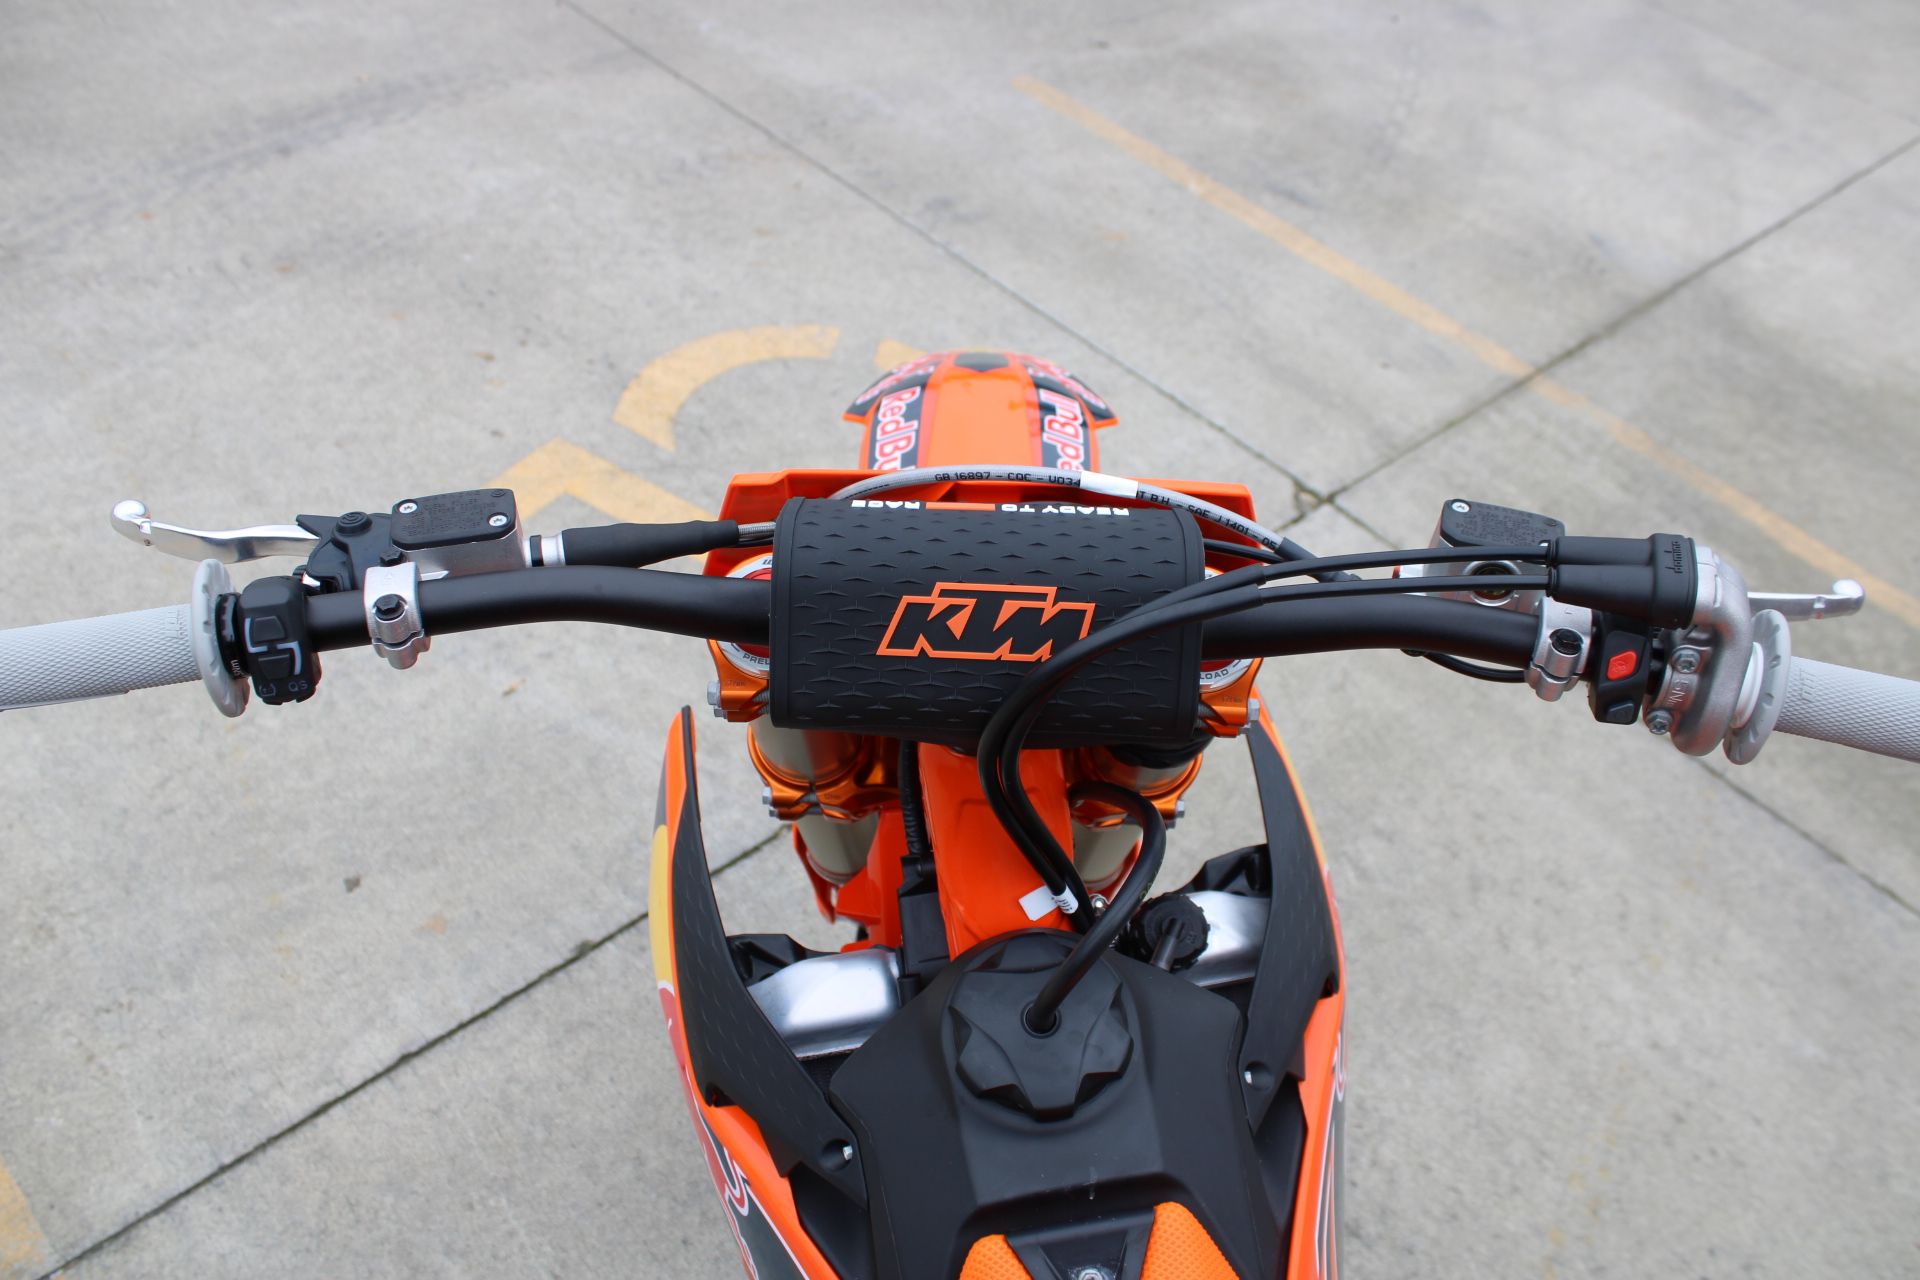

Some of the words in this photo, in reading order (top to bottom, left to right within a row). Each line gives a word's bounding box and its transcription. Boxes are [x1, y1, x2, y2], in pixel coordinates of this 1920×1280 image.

[873, 431, 917, 470] Bu
[1042, 432, 1084, 471] ed
[935, 473, 950, 482] GB
[955, 471, 990, 480] 16897
[1001, 503, 1035, 513] TO
[1041, 504, 1130, 516] READY
[1187, 504, 1211, 519] SAE
[876, 581, 1096, 663] KTM
[1199, 668, 1229, 680] LOAD
[288, 680, 308, 692] QS
